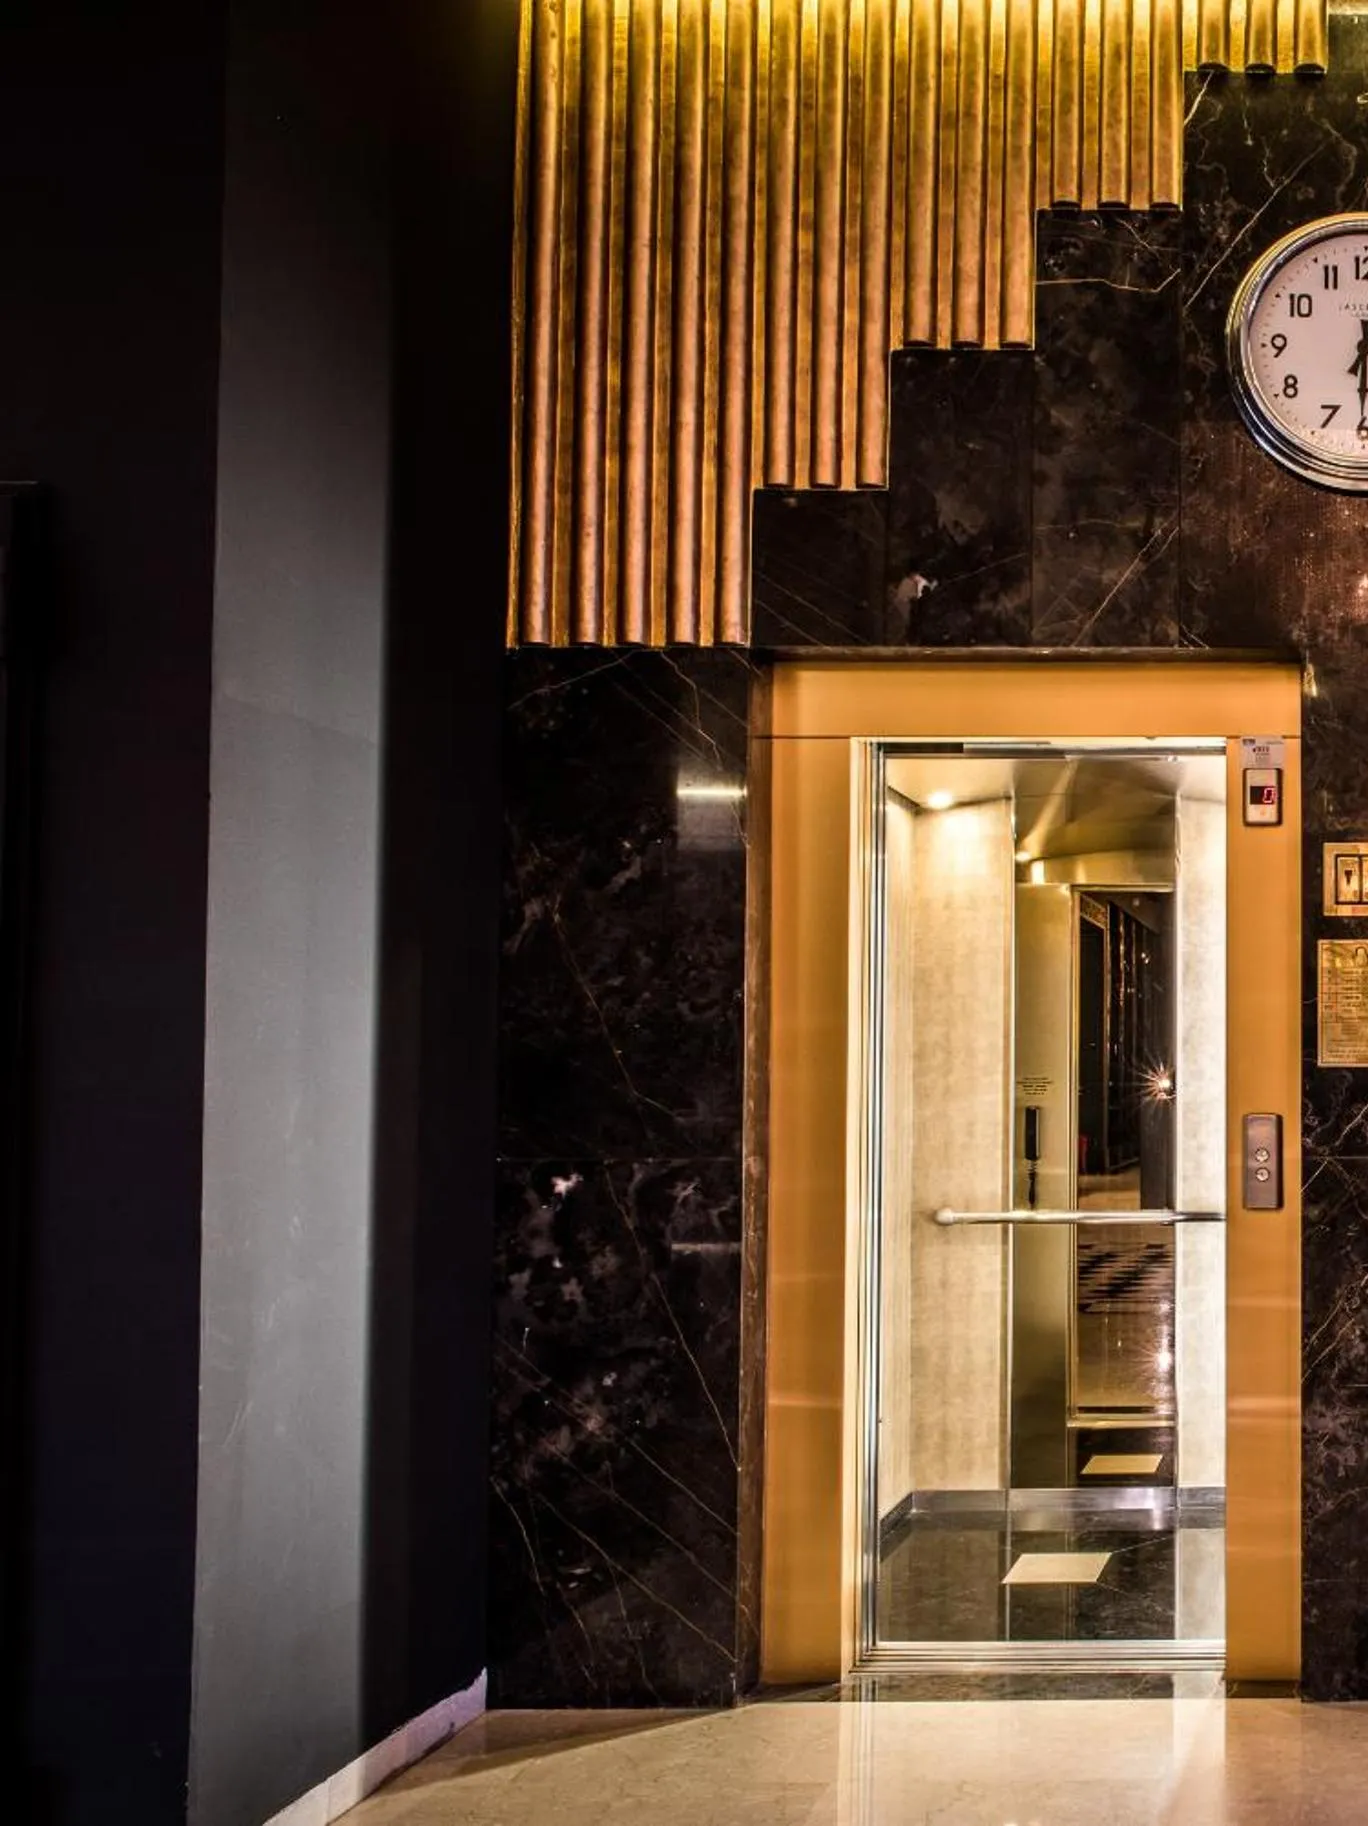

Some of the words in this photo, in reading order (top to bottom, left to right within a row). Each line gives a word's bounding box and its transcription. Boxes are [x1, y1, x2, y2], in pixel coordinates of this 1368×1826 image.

[1323, 264, 1338, 290] 11
[1289, 293, 1313, 318] 10
[1270, 333, 1288, 358] 9
[1282, 374, 1298, 399] 8
[1320, 405, 1342, 429] 7
